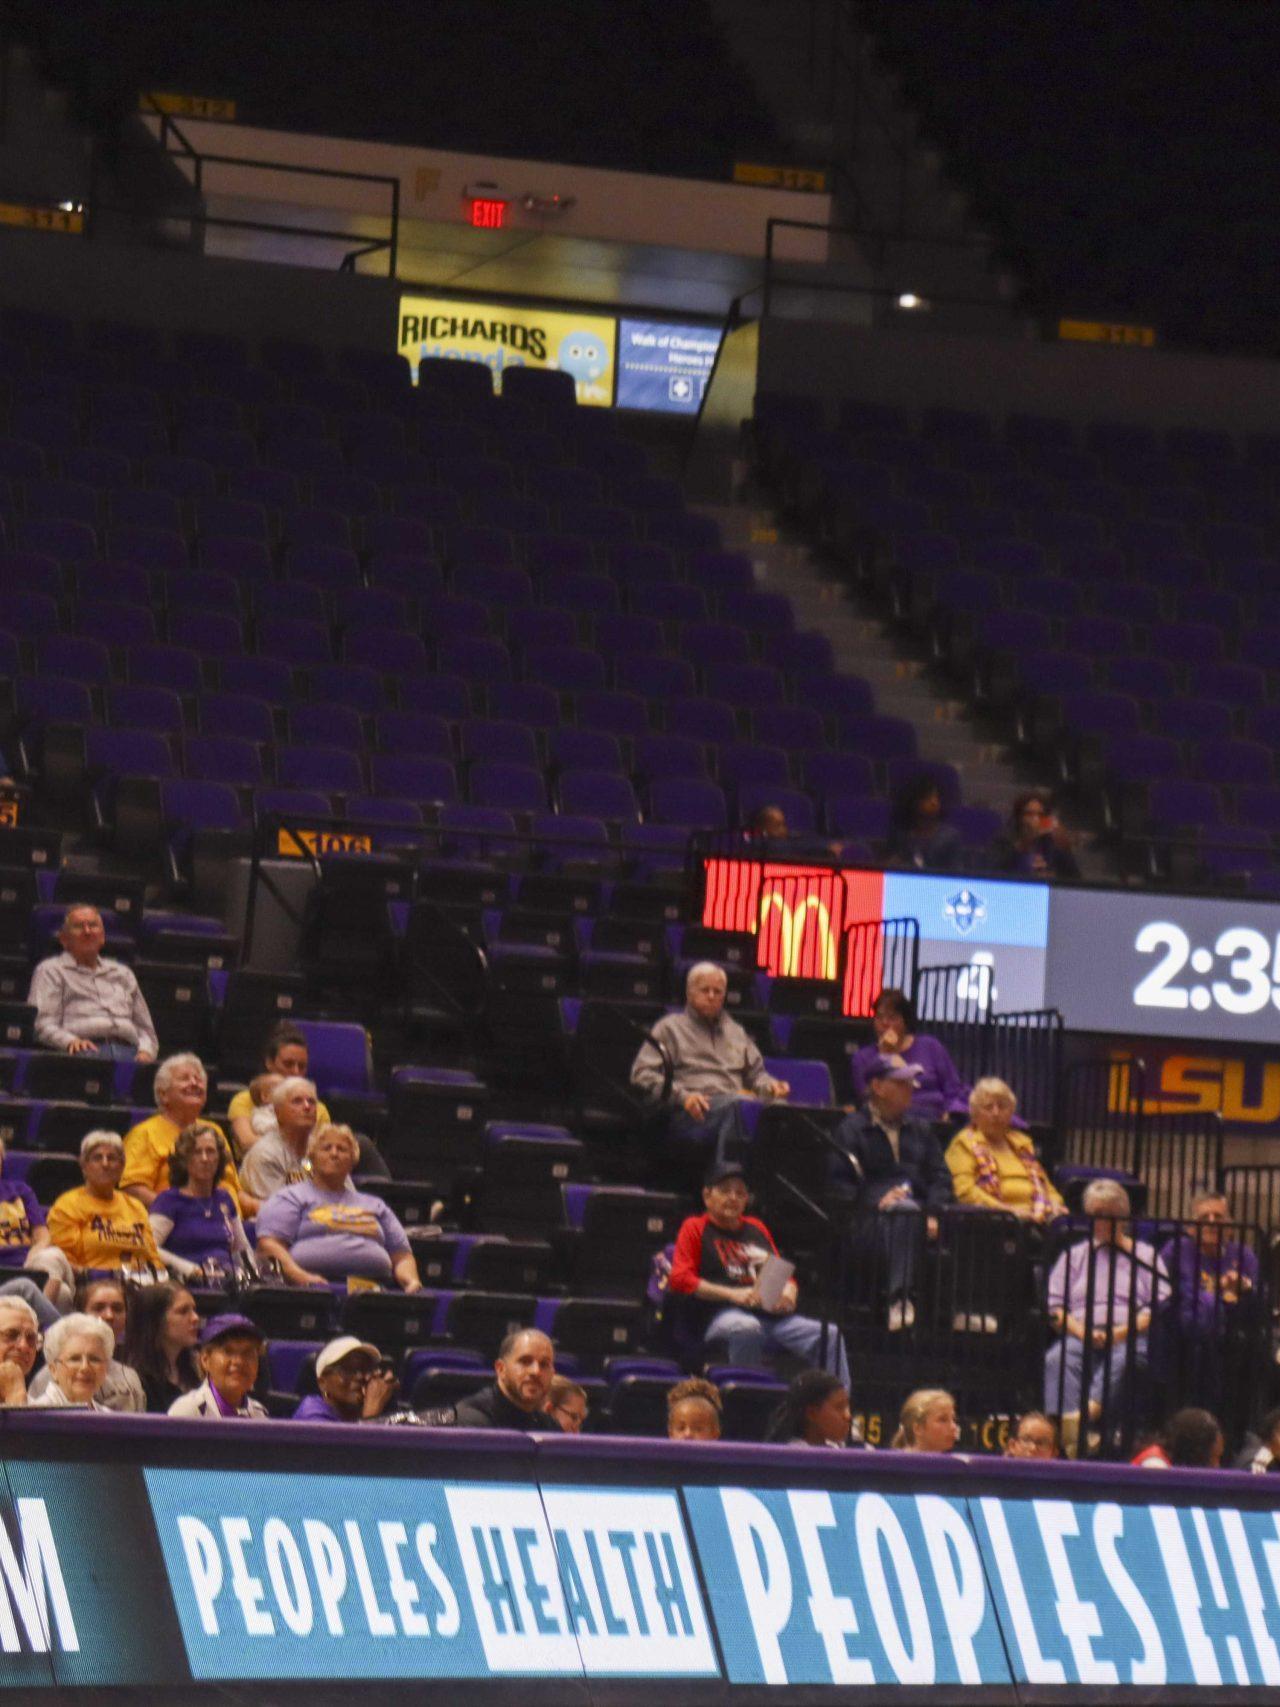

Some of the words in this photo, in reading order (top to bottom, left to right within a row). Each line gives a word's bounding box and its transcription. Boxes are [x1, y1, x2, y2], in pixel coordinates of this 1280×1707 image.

[472, 200, 504, 229] EXIT
[401, 315, 547, 361] RICHARDS
[176, 1514, 461, 1638] PEOPLES
[470, 1525, 696, 1637] HEALTH
[718, 1486, 1168, 1686] PEOPLES
